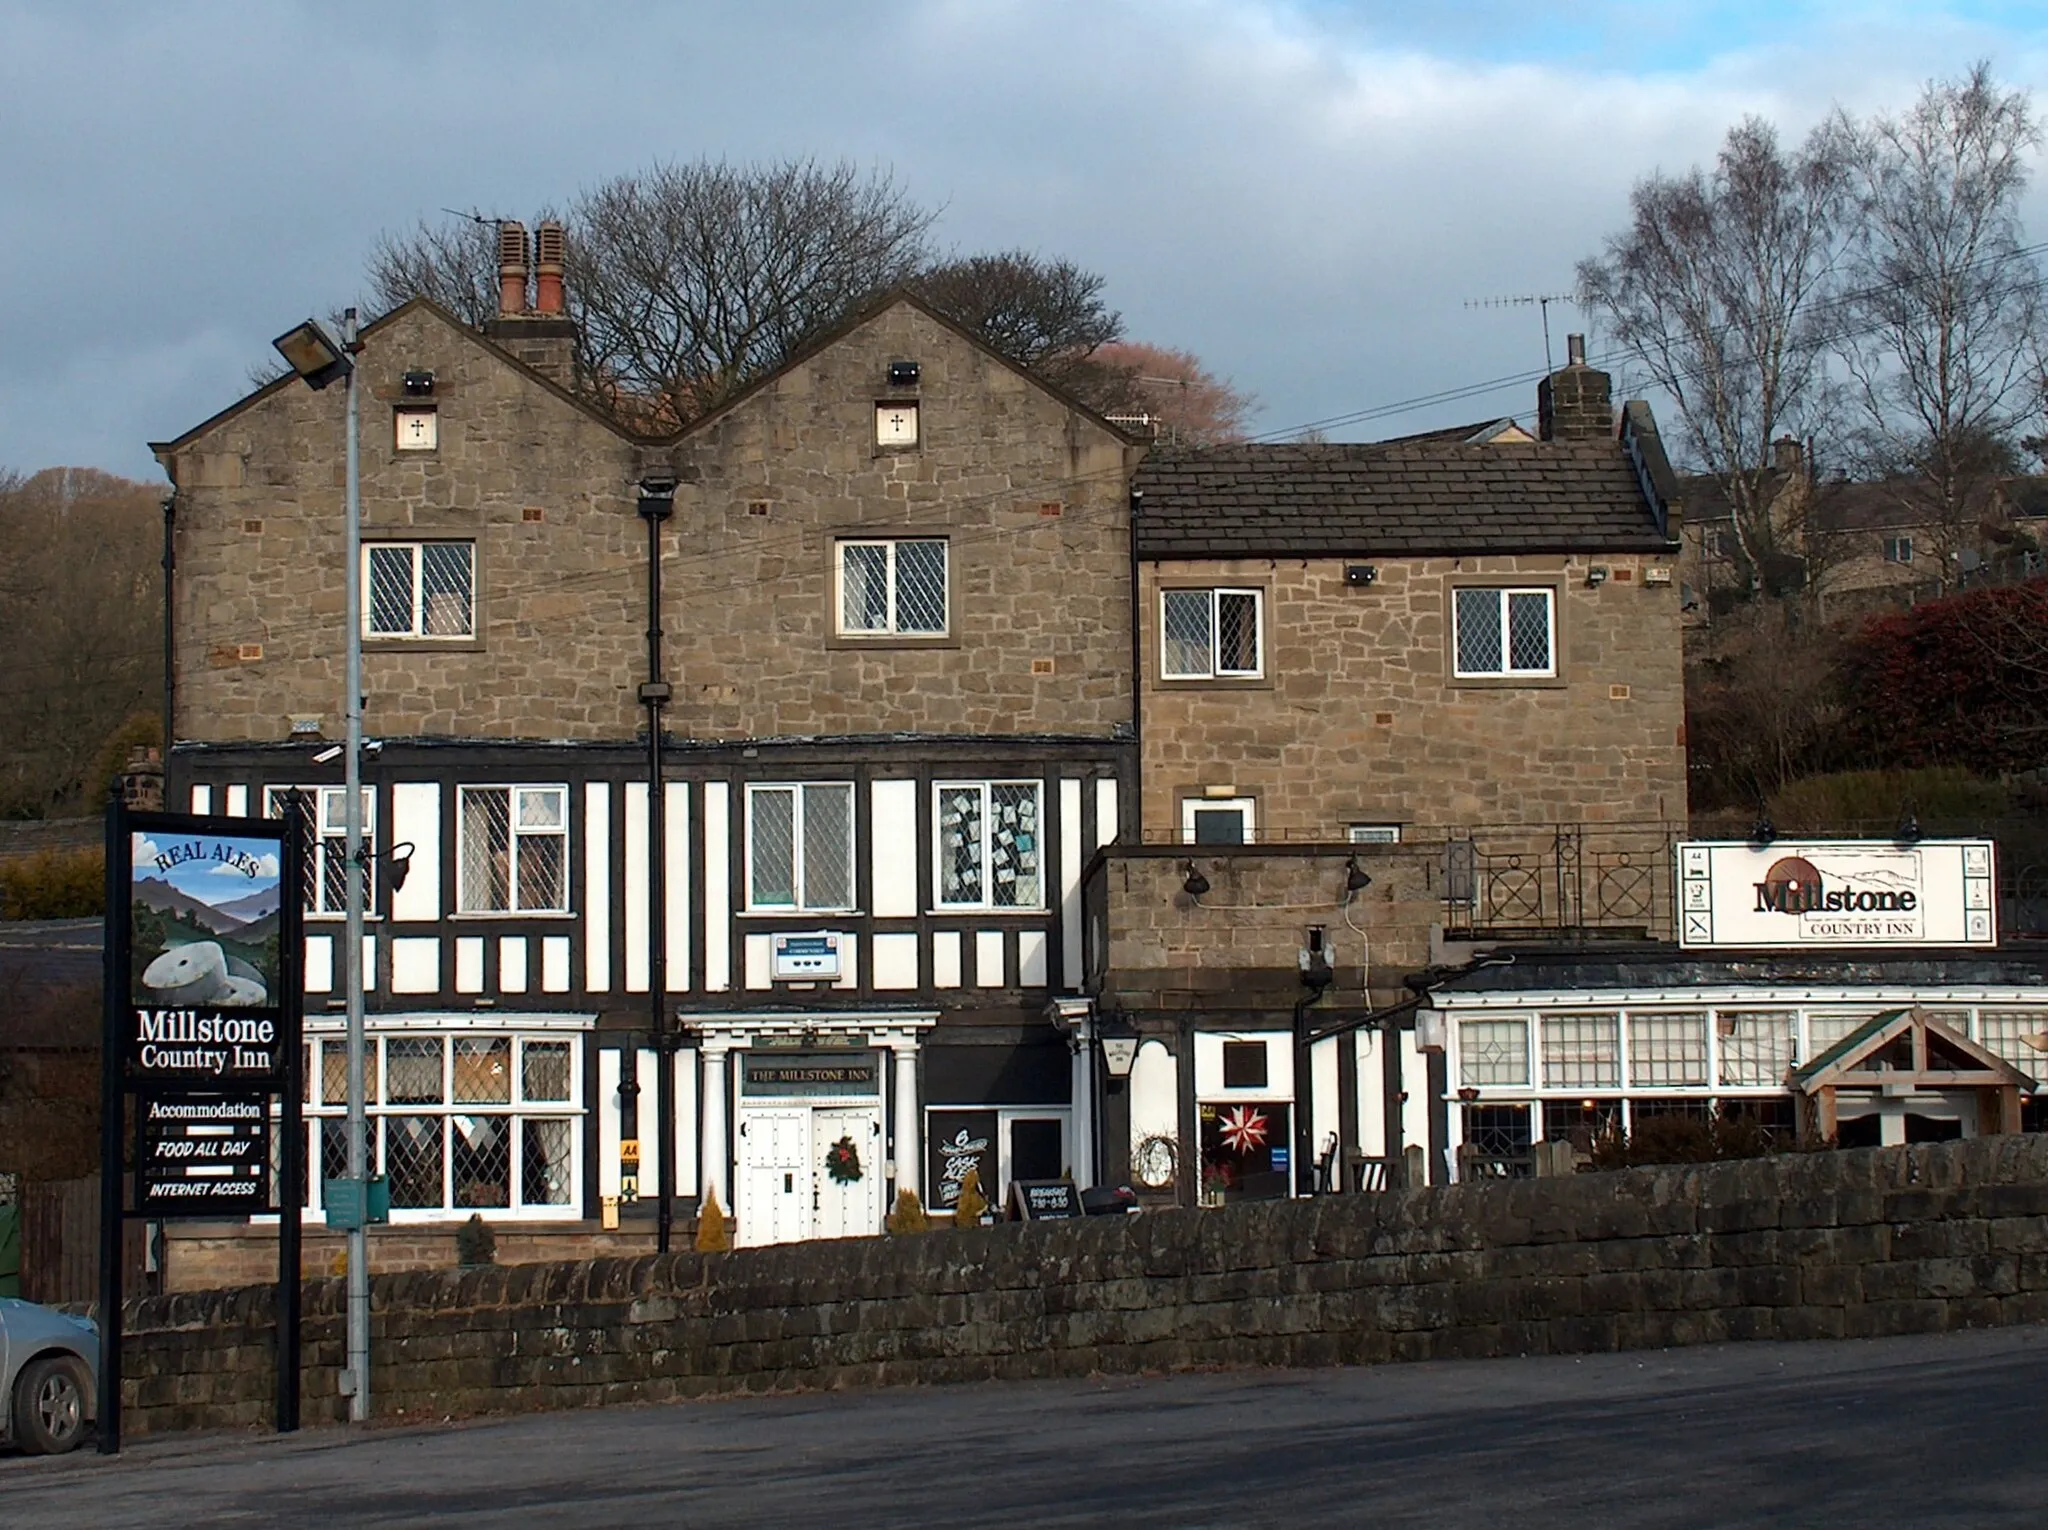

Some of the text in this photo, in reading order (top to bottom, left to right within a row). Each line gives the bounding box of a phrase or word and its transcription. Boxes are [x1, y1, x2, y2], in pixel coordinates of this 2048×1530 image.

[153, 841, 260, 879] REAL ALES
[1753, 880, 1917, 912] Millstone
[1810, 923, 1914, 935] COUNTRY INN
[136, 1009, 275, 1043] Millstone
[141, 1044, 271, 1075] Country Inn
[752, 1069, 870, 1082] THE MILLSTONE INN
[148, 1100, 260, 1118] Accommodation
[154, 1141, 251, 1157] FOOD ALL DAY
[945, 1155, 980, 1169] CASK
[149, 1181, 256, 1197] INTERNET ACCESS
